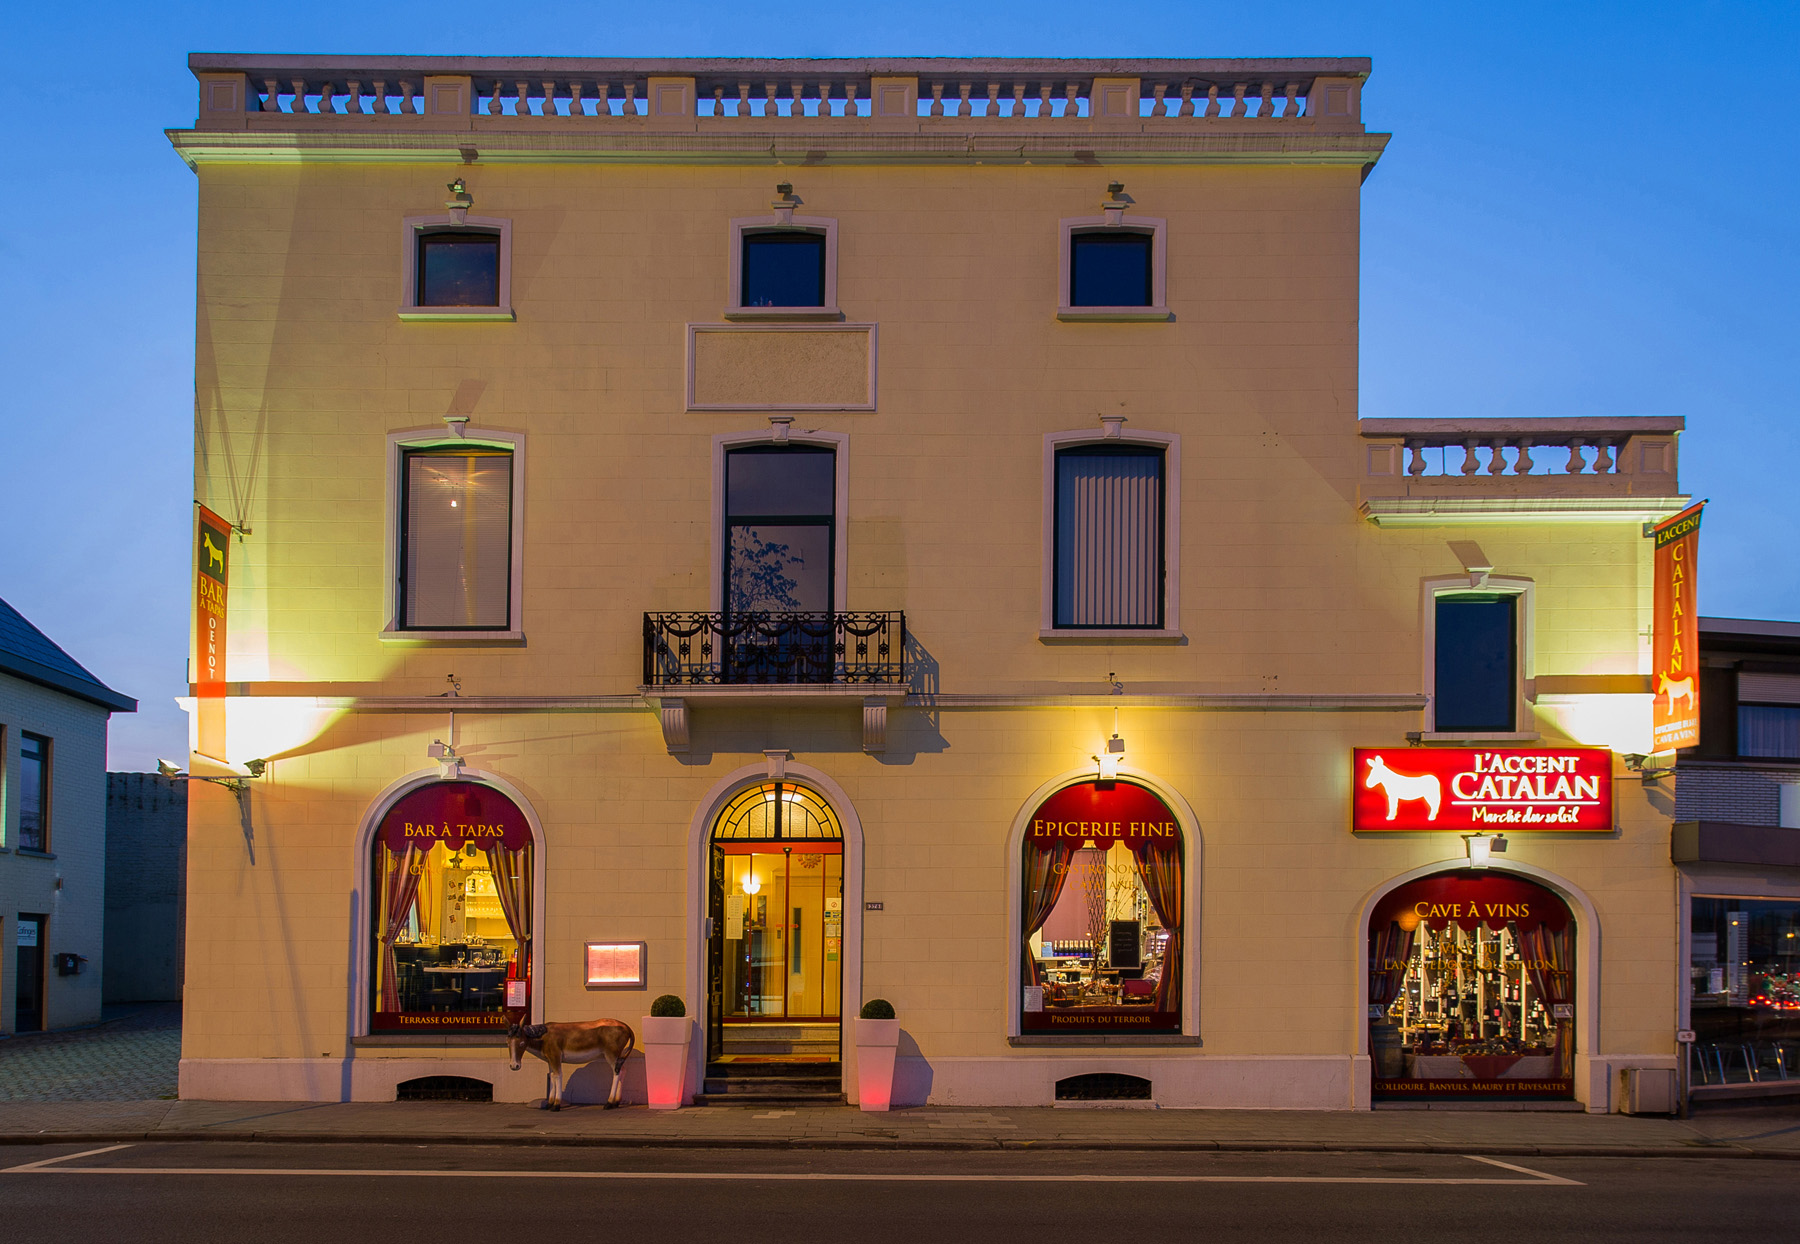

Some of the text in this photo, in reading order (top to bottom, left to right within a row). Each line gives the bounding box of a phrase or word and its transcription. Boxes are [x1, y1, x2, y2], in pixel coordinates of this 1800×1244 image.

[1657, 514, 1700, 545] L'ACCENT
[200, 576, 224, 607] BAR
[206, 599, 225, 619] TAPAS
[1672, 543, 1684, 674] CATALAN
[208, 617, 216, 679] OENOT
[1475, 753, 1580, 773] L'ACCENT
[1451, 772, 1600, 799] CATALAN
[1521, 806, 1545, 823] du
[1545, 806, 1580, 823] soleil
[404, 822, 504, 837] BAR À TAPAS
[1033, 820, 1174, 837] EPICERIE FINE
[1053, 862, 1152, 875] GASTRONOMIE
[1069, 880, 1135, 891] CATALANE
[1414, 900, 1529, 917] CAVE À VINS
[1384, 959, 1556, 970] LANUEDOC-ROUSSILON
[399, 1015, 439, 1024] TERRASSE
[442, 1016, 480, 1024] OUVERTE
[1052, 1015, 1095, 1023] PRODUITS
[1472, 1083, 1503, 1091] MAURY
[1506, 1083, 1516, 1091] ET
[1518, 1083, 1567, 1091] RIVESALTES
